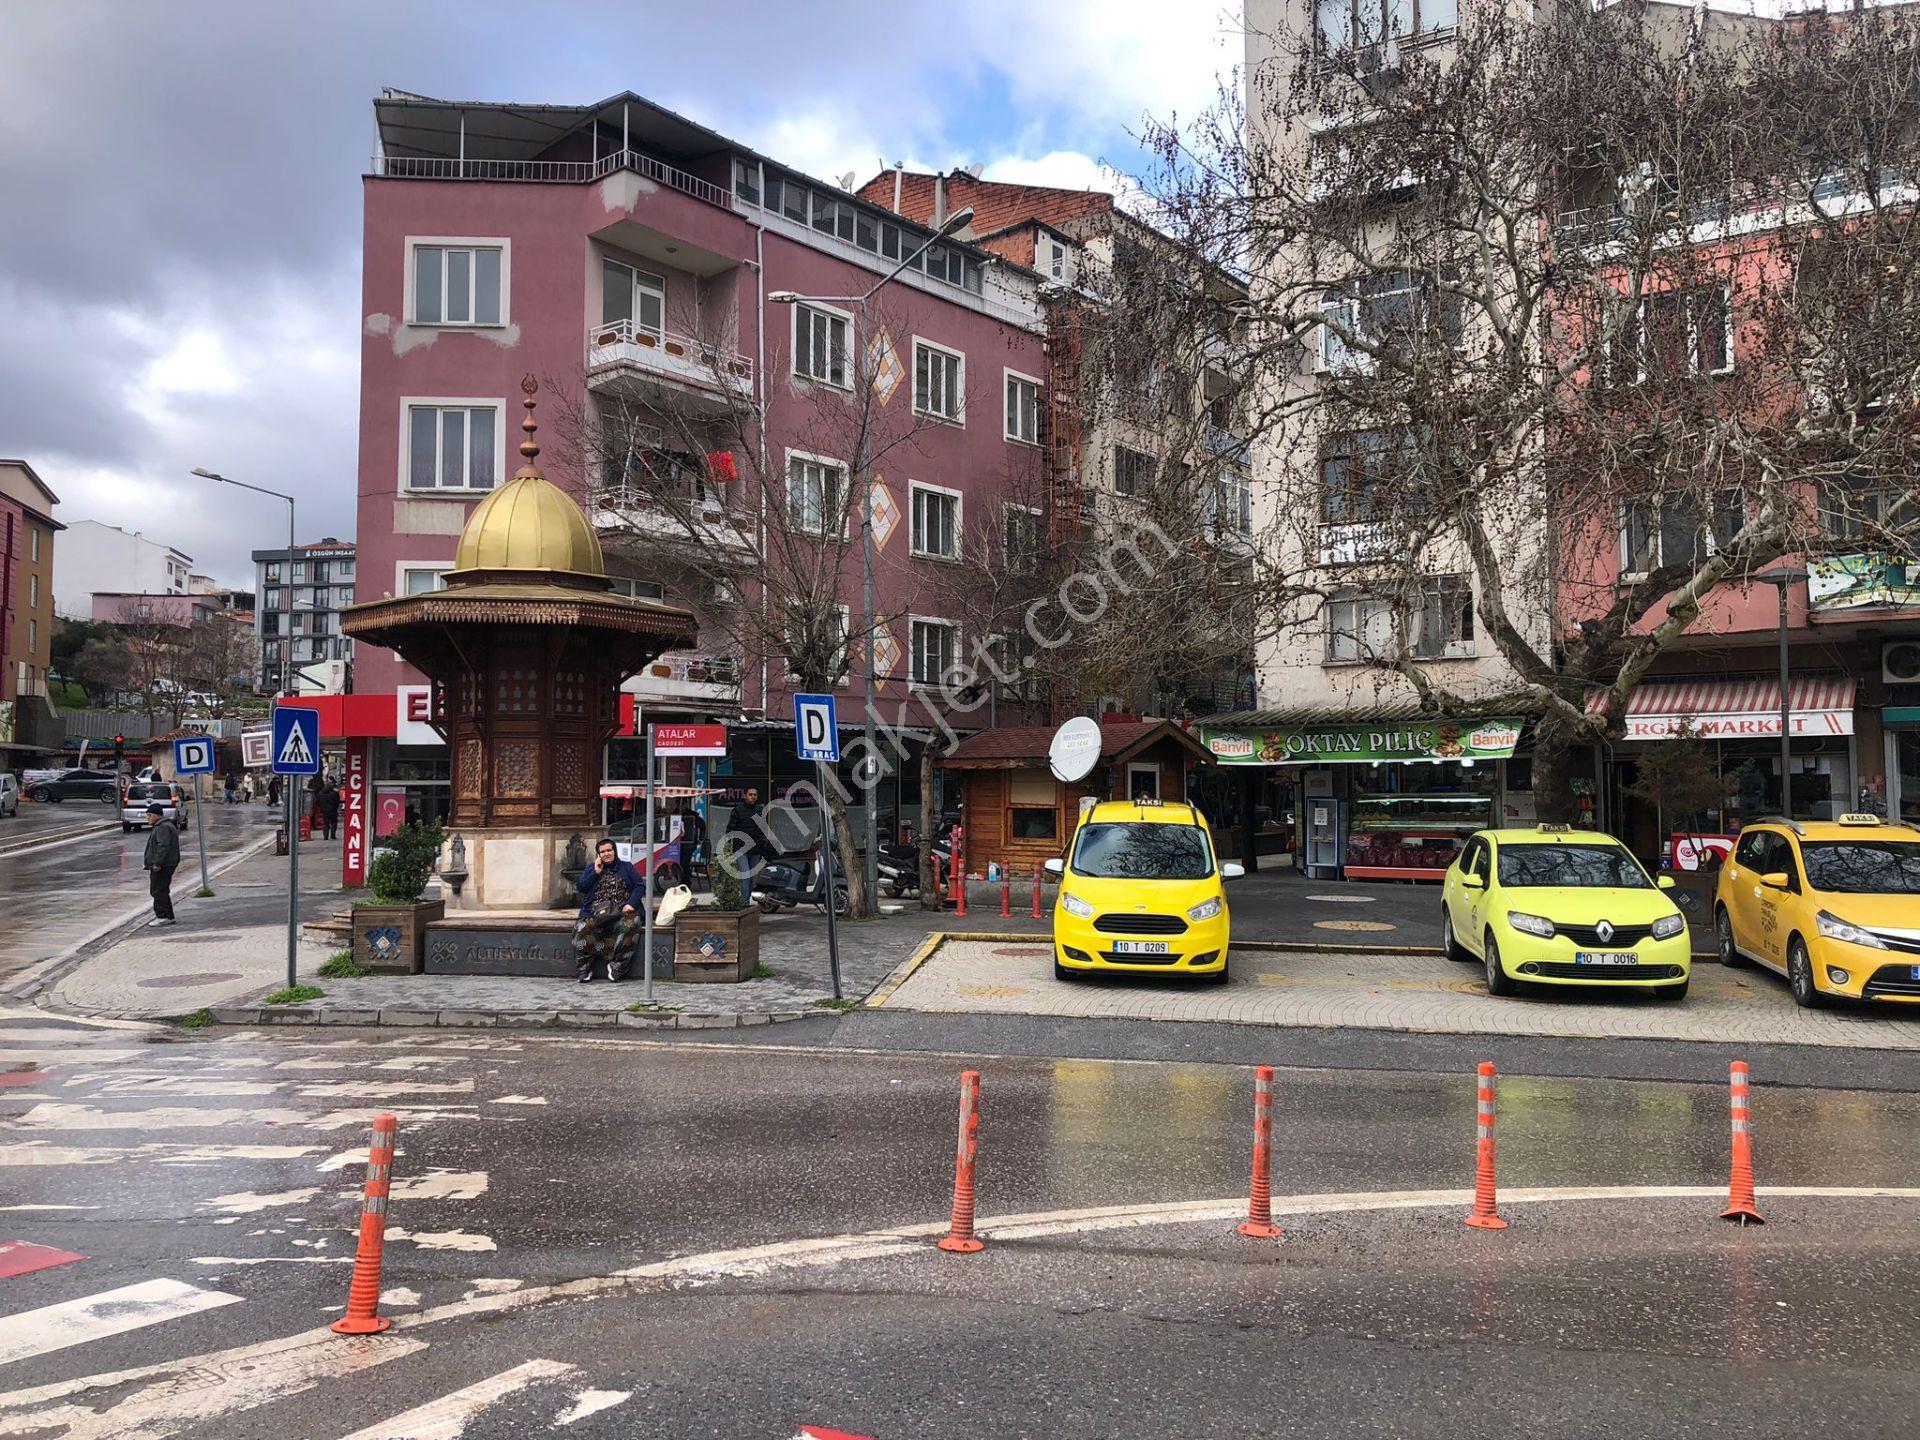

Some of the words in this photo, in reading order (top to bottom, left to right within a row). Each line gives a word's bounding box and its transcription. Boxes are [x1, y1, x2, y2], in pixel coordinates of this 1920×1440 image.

[806, 710, 825, 744] D
[1700, 717, 1808, 734] MARKT
[657, 729, 696, 739] ATALAR
[1472, 733, 1515, 747] Banvit
[1211, 741, 1251, 753] Banvit
[1286, 733, 1362, 753] OKTAY
[185, 746, 204, 766] D
[813, 751, 835, 760] ARAÇ
[348, 755, 362, 869] ECZANE
[1119, 942, 1129, 951] 10
[1134, 942, 1139, 951] T
[1144, 943, 1166, 952] 0209
[1582, 953, 1593, 963] 10
[1600, 954, 1606, 963] T
[1613, 954, 1636, 964] 0016
